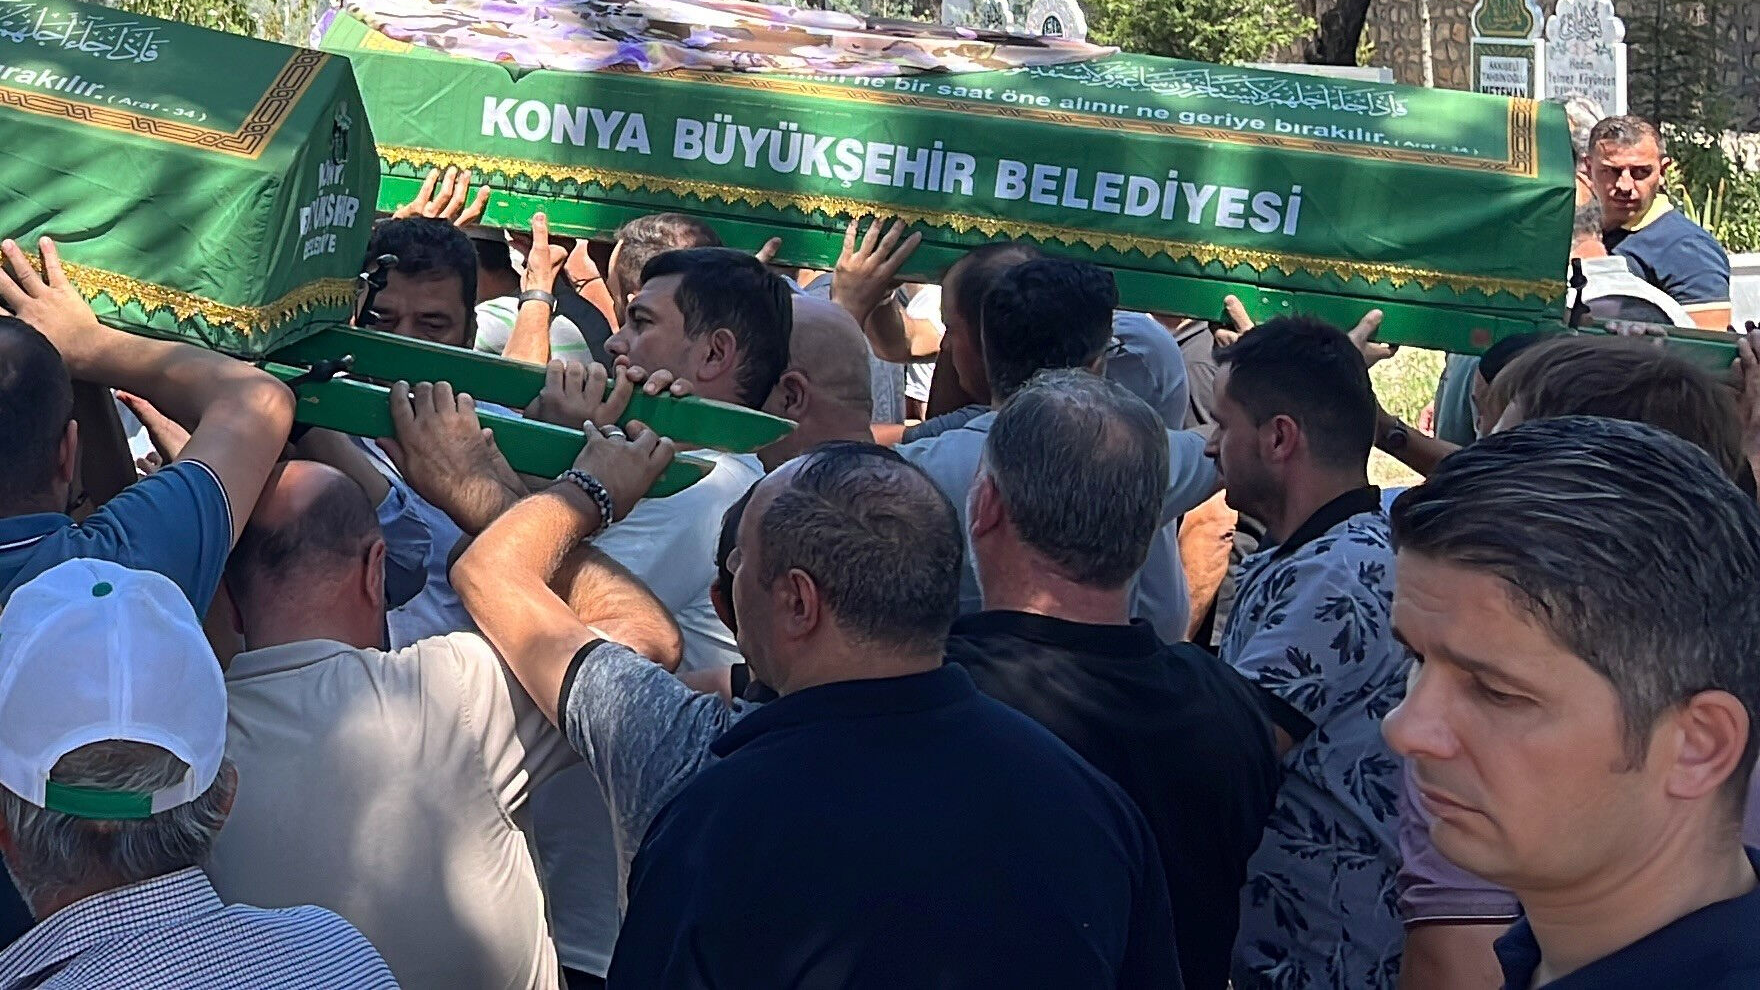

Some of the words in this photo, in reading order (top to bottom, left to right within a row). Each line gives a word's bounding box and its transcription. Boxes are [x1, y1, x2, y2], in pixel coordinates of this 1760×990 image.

[893, 76, 931, 94] bir
[936, 83, 994, 101] saat
[1001, 88, 1051, 108] öne
[1059, 95, 1129, 116] alınır
[1136, 104, 1171, 121] ne
[1178, 108, 1266, 132] geriye
[481, 95, 651, 156] KONYA
[672, 113, 976, 196] BÜYÜKŞEHİR
[994, 159, 1303, 237] BELEDİYESİ
